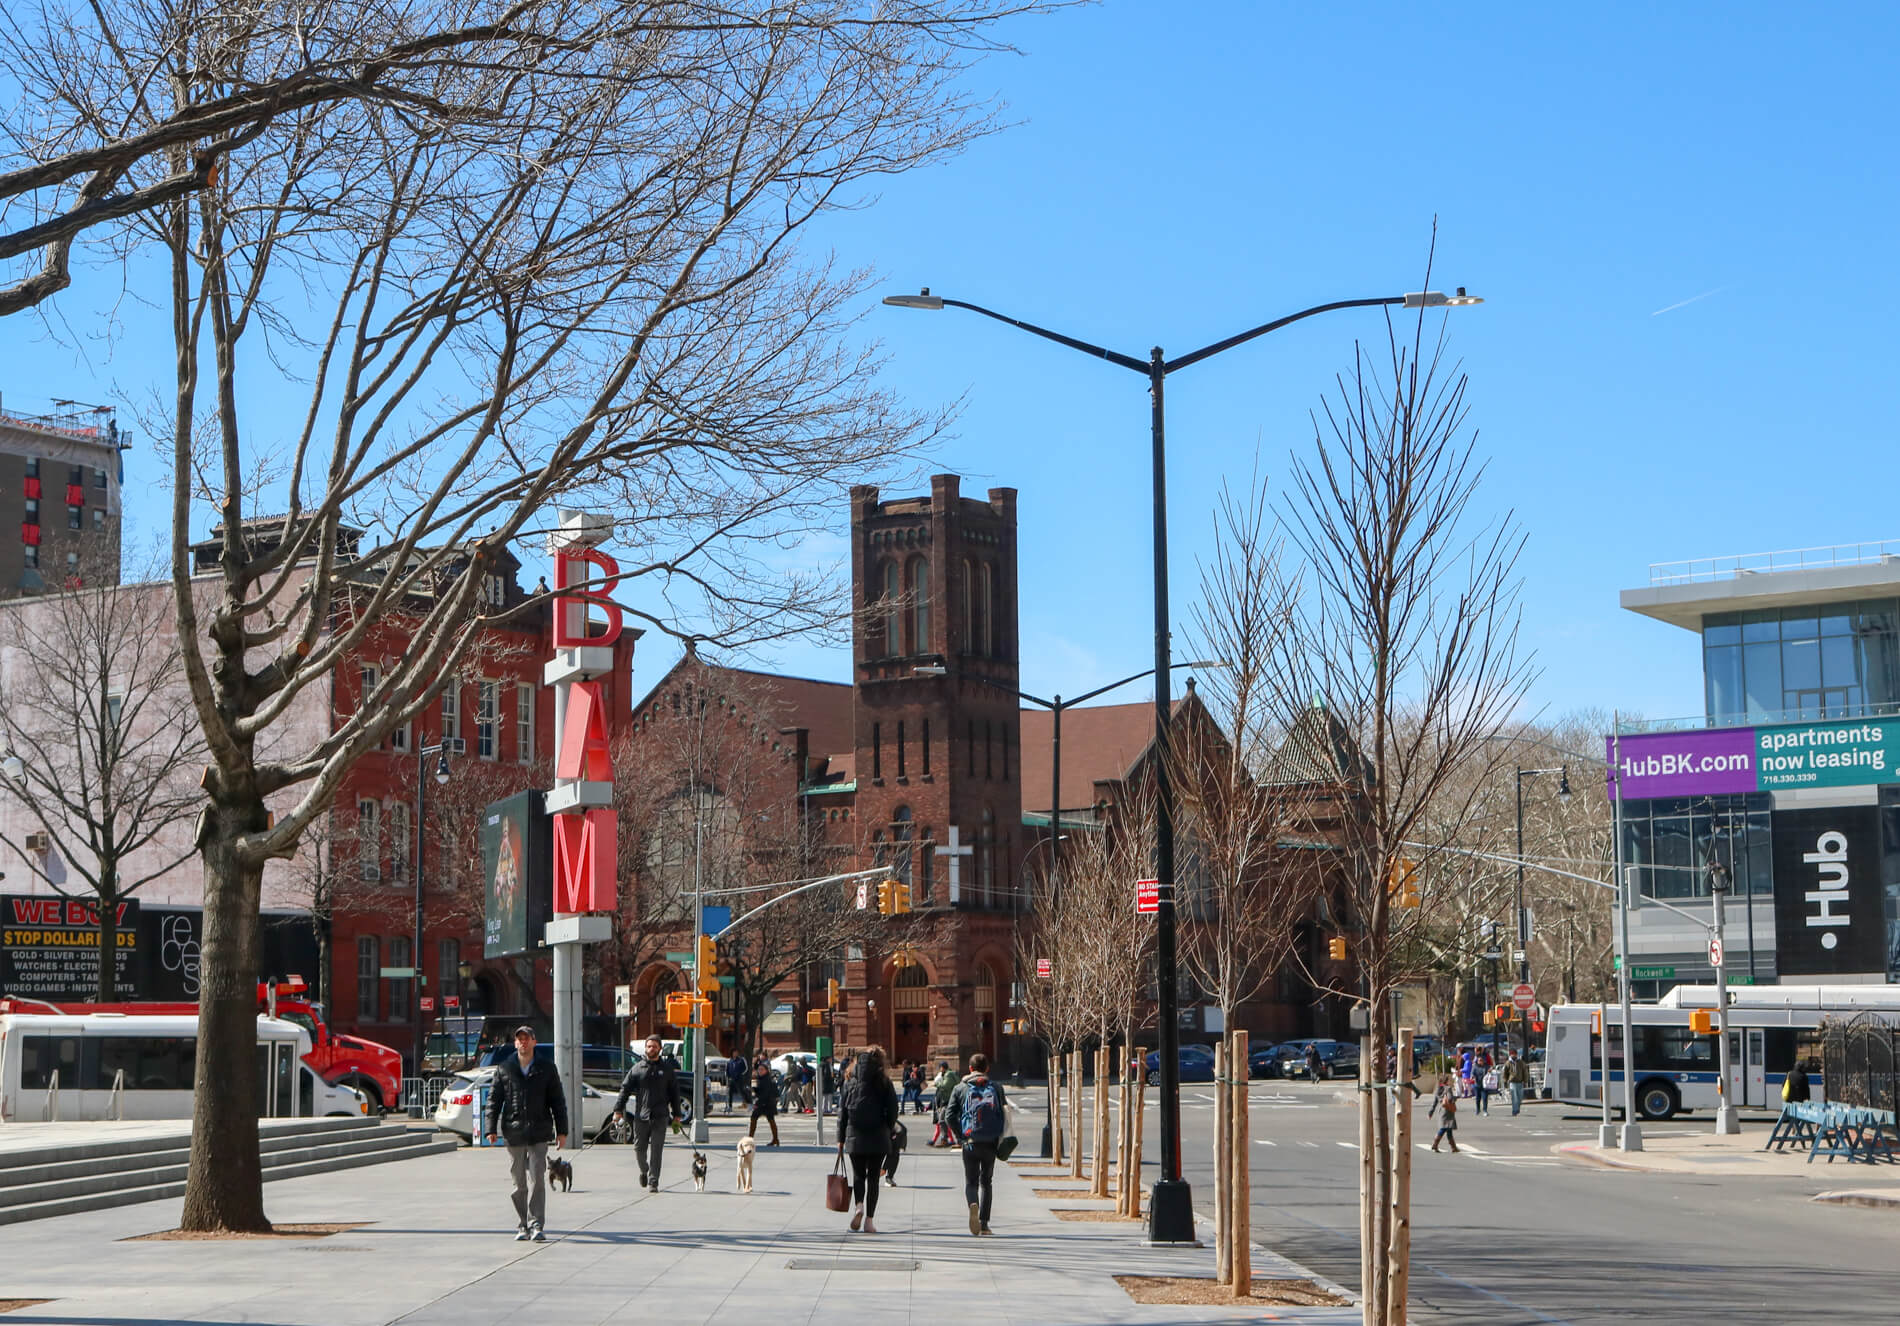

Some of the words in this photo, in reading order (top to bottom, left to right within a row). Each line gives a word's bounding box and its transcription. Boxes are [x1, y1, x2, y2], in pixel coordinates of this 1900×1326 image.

[551, 549, 624, 914] BAM
[1760, 725, 1883, 752] apartments
[1620, 753, 1749, 777] HubBK.com
[1762, 754, 1804, 772] now
[1808, 747, 1886, 770] leasing
[1803, 830, 1851, 927] Hub
[12, 899, 62, 924] WE
[14, 931, 41, 945] TOP
[43, 932, 95, 945] DOLLAR
[12, 951, 37, 960] GOLD
[43, 951, 75, 960] SILVER
[14, 962, 58, 971] WATCHES
[4, 984, 32, 993] VIDEO
[33, 984, 66, 993] GAMES
[19, 973, 76, 982] COMPUTERS
